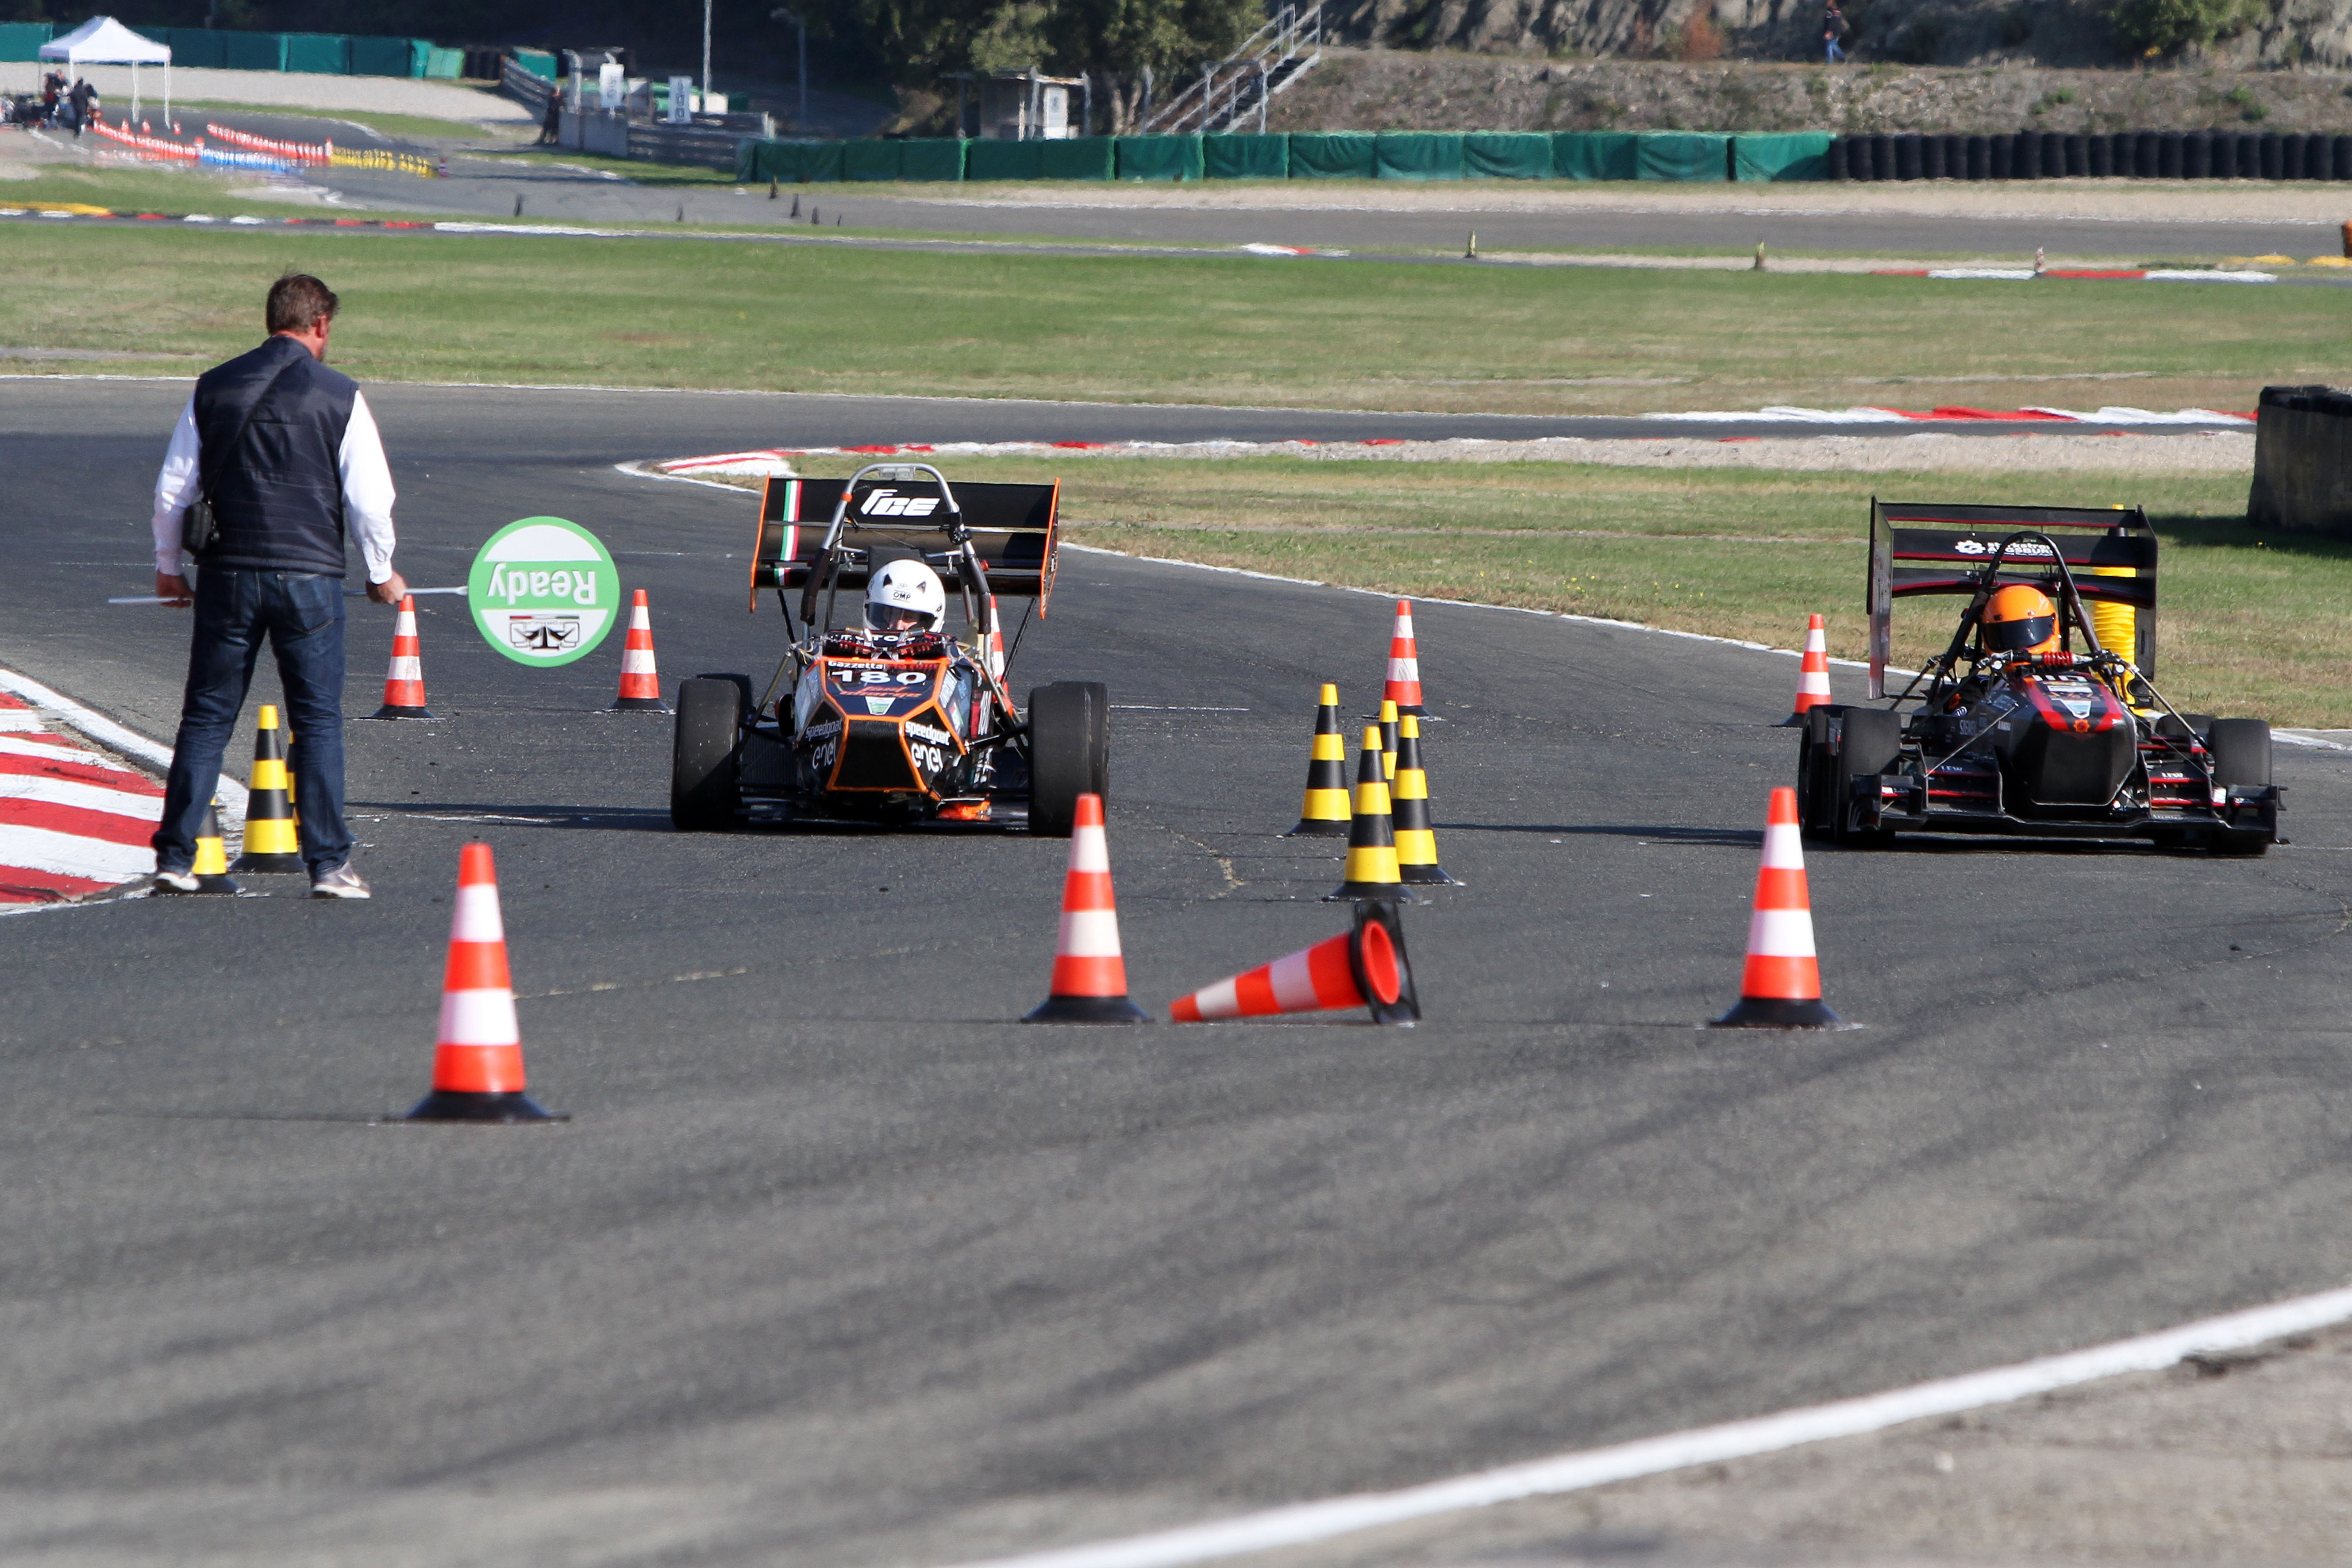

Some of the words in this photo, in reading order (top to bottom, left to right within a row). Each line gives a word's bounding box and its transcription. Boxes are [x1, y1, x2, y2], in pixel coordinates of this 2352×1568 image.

[487, 562, 598, 605] Ready
[893, 592, 911, 600] OMP
[828, 661, 882, 669] Gazzetta
[831, 670, 927, 685] 180
[806, 719, 842, 741] speedgoat
[905, 720, 951, 746] speedgoat
[812, 736, 837, 769] enel
[911, 743, 943, 773] enel
